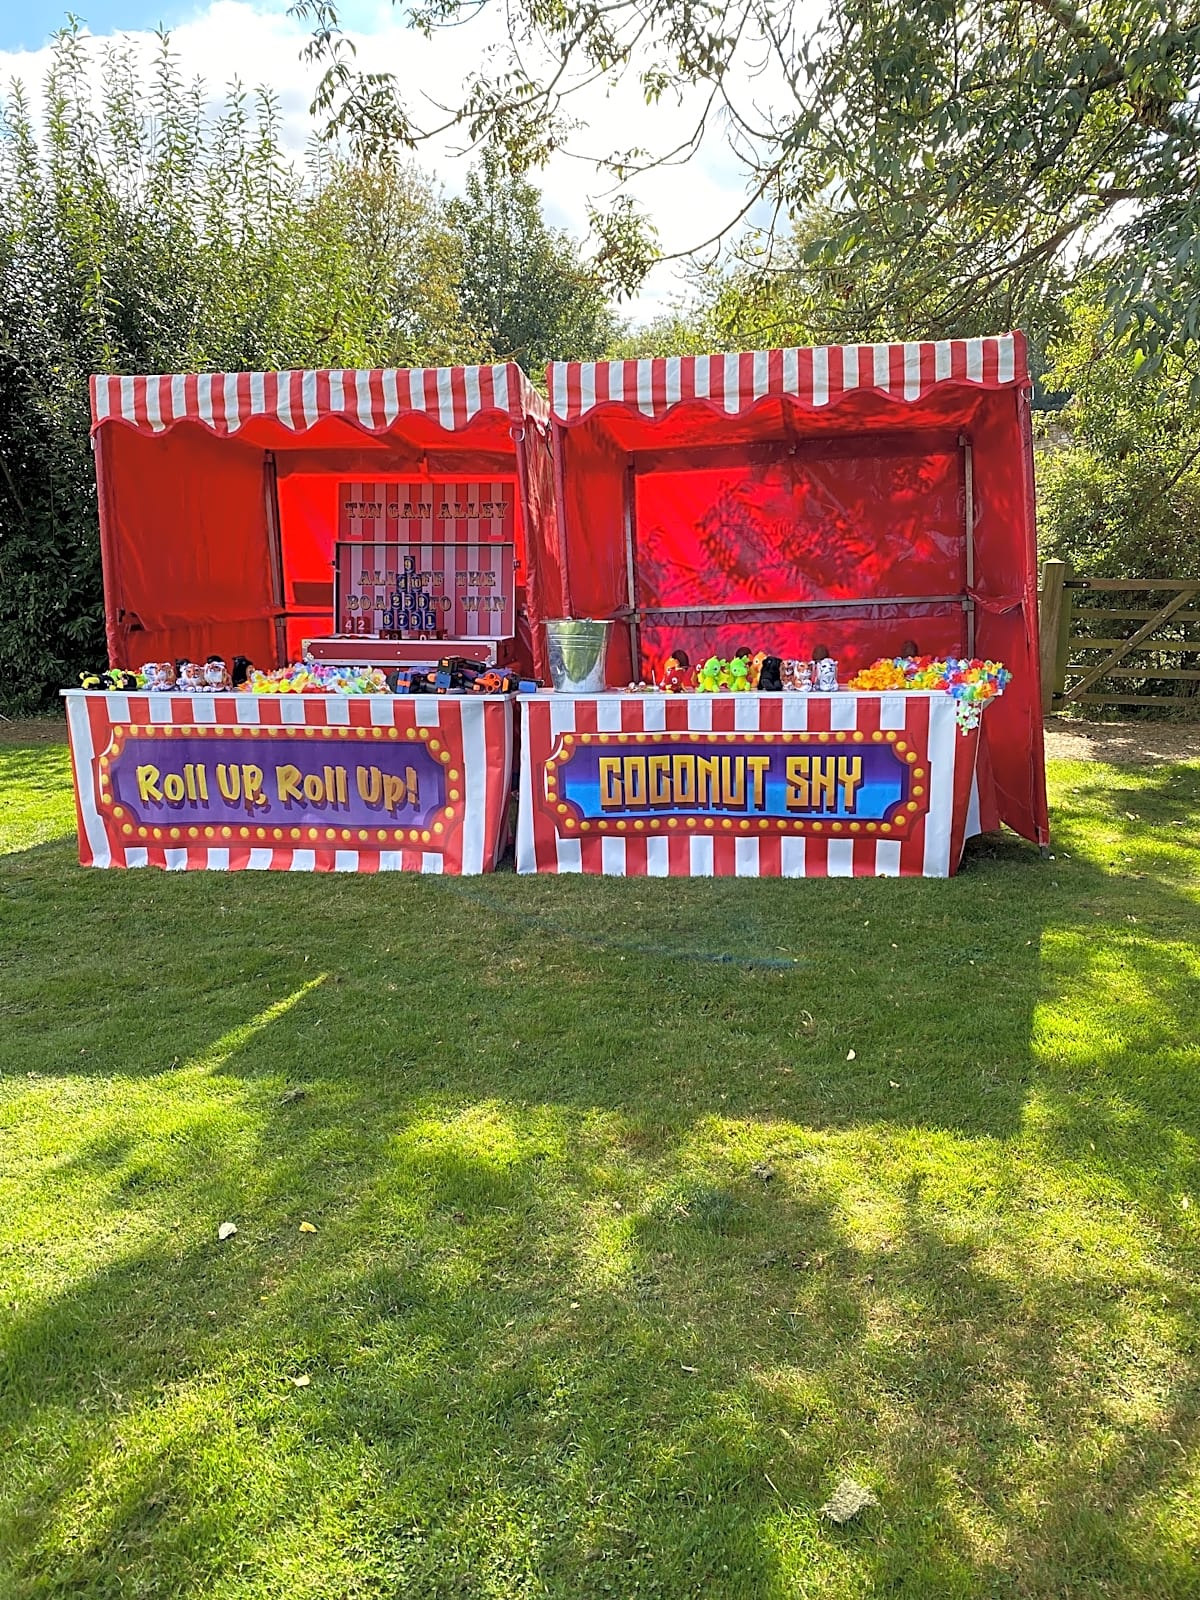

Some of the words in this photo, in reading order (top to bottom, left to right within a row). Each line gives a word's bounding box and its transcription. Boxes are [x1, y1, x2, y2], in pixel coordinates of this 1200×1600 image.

[345, 502, 382, 519] TIN
[387, 502, 432, 519] CAN
[438, 502, 508, 519] ALLEY
[455, 571, 496, 587] THE
[346, 595, 387, 611] BOA
[428, 596, 452, 612] TO
[461, 596, 507, 612] WIN
[135, 764, 209, 803] Roll
[275, 765, 346, 804] Roll
[355, 765, 418, 813] Up!
[598, 754, 771, 808] COCONUT
[785, 756, 863, 808] SHY
